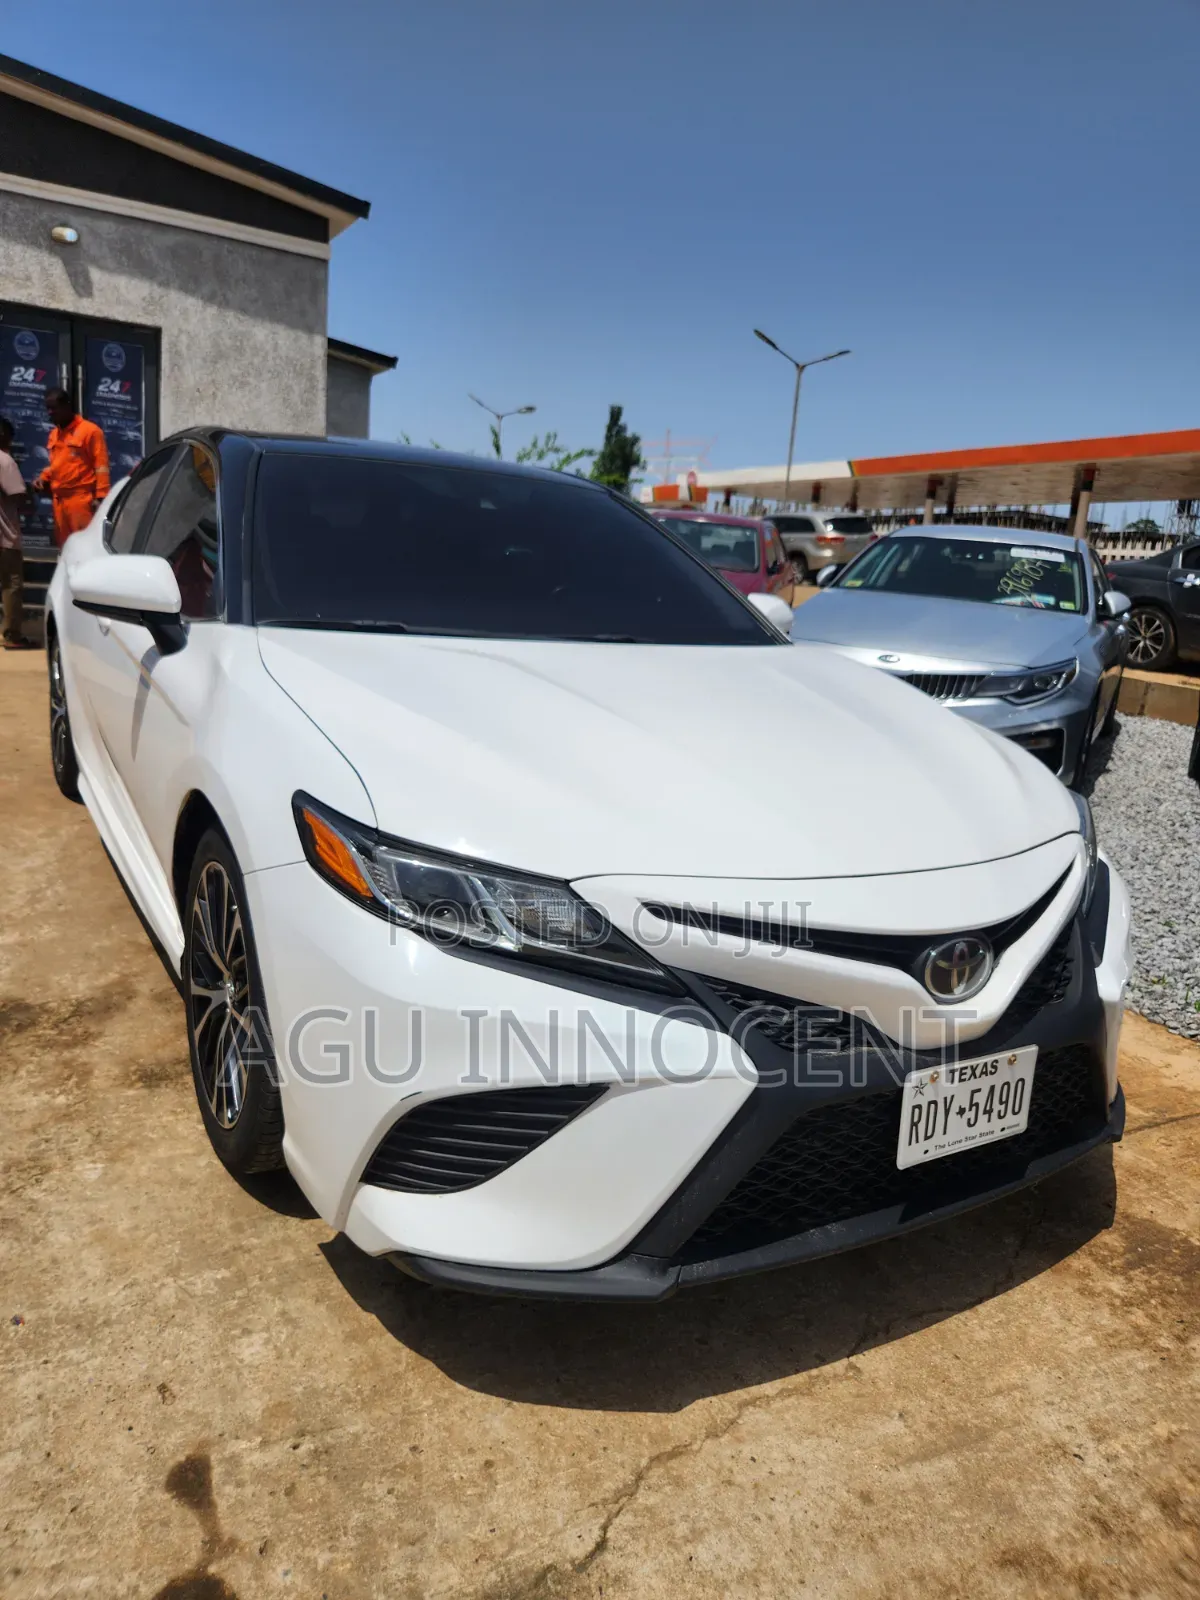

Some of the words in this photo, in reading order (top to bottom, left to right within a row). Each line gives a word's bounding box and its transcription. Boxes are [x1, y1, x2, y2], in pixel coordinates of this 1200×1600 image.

[949, 1059, 999, 1084] TEXAS
[908, 1094, 955, 1147] RDY
[966, 1077, 1026, 1128] 5490
[934, 1143, 946, 1151] The
[947, 1138, 963, 1147] Lone
[964, 1134, 978, 1142] Star
[978, 1129, 995, 1138] State
